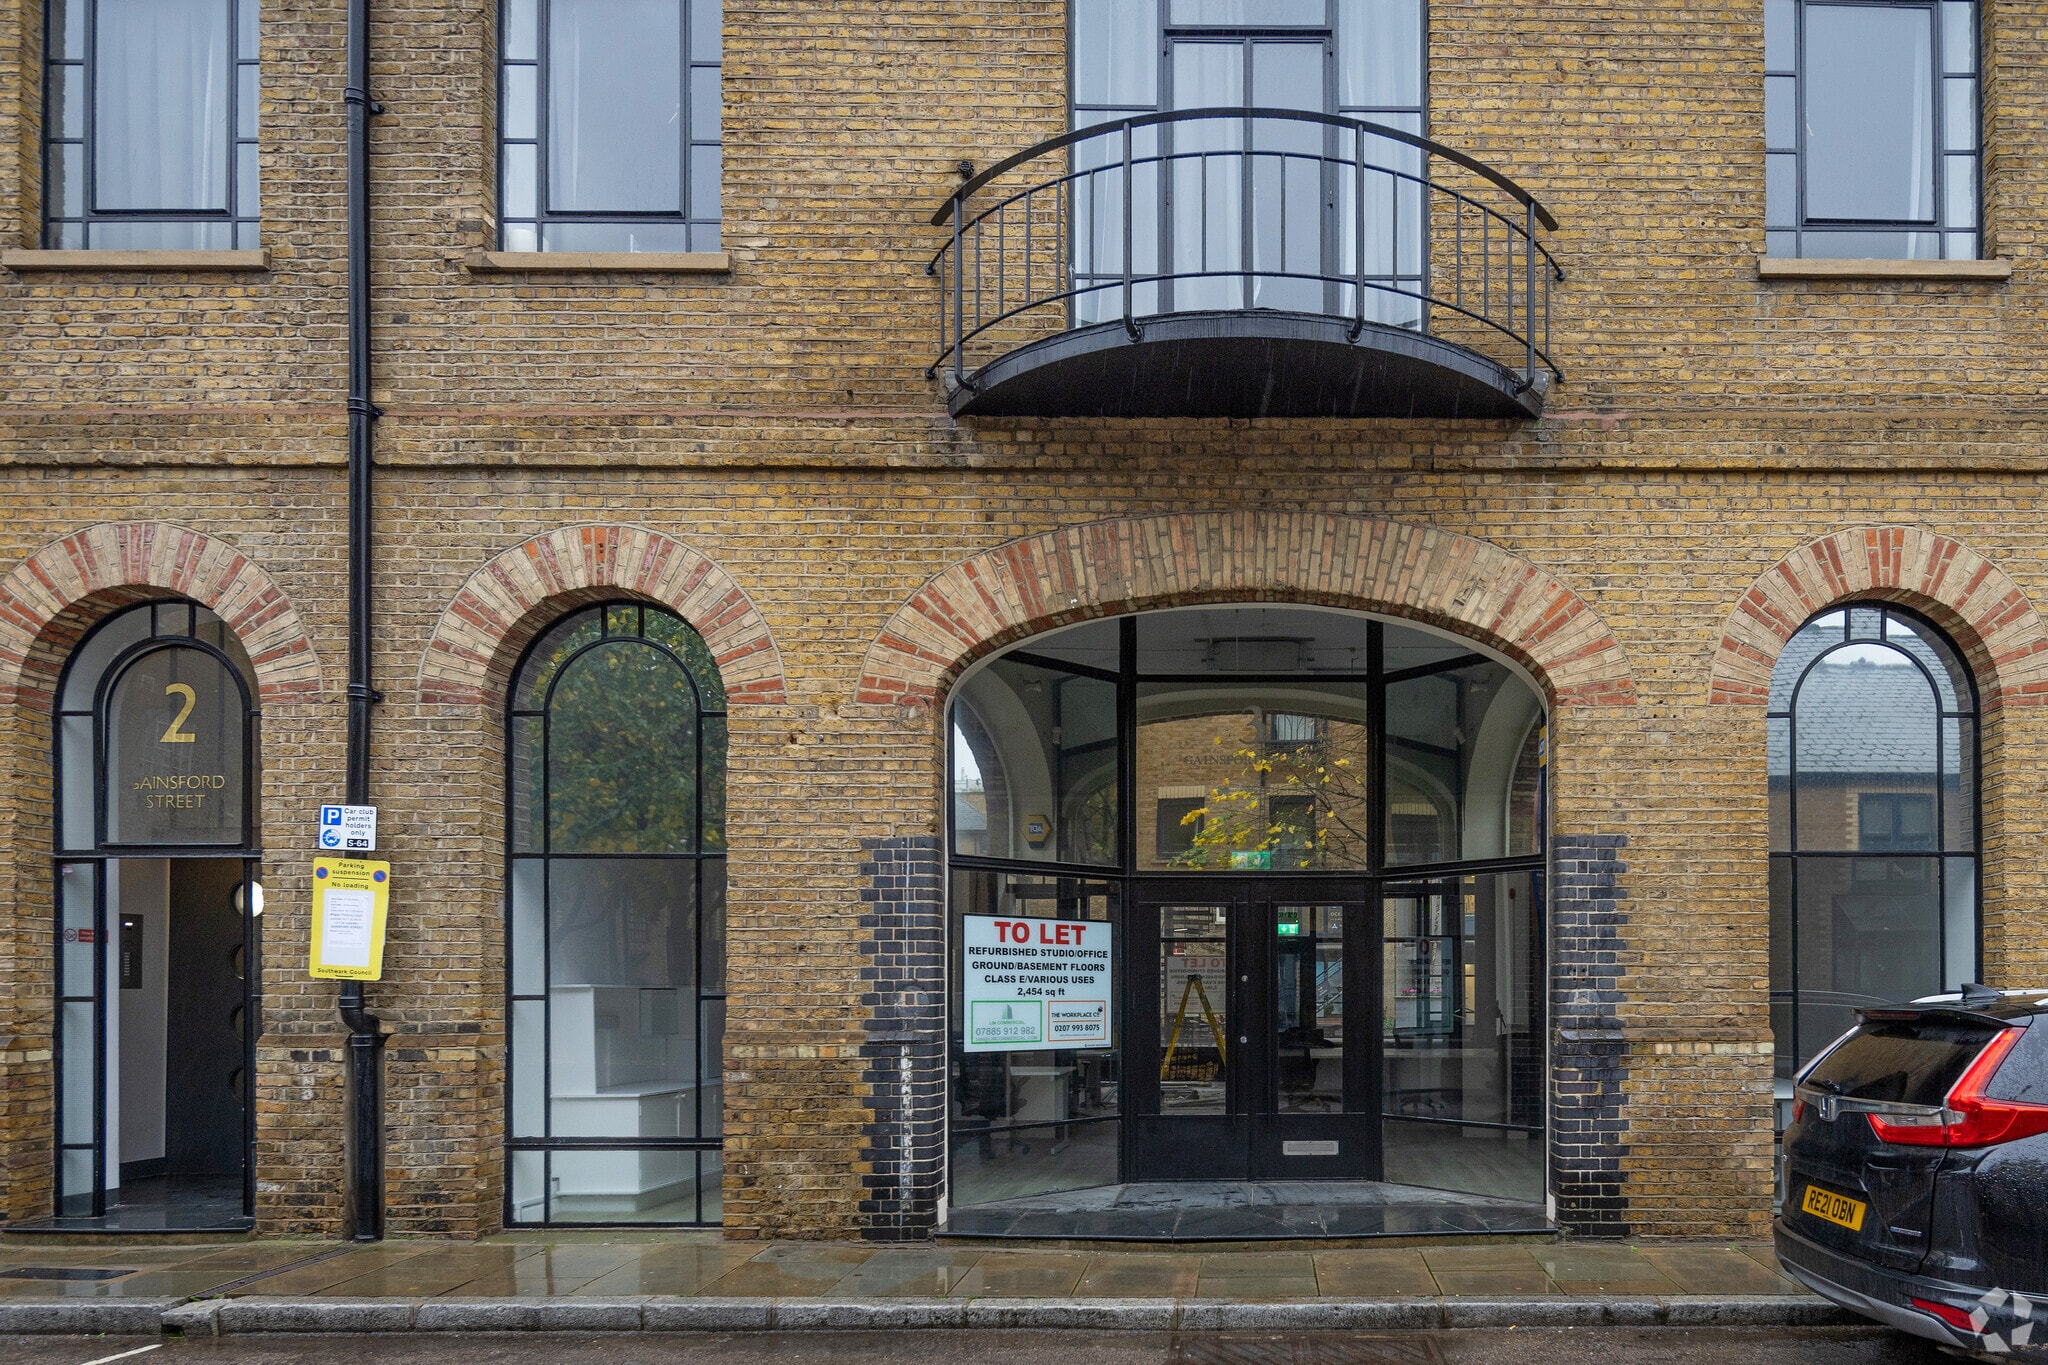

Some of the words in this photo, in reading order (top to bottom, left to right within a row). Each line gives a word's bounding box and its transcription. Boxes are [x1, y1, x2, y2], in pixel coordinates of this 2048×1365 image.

[160, 683, 196, 742] 2
[1238, 705, 1266, 744] 3
[146, 794, 206, 809] STREET
[327, 809, 340, 824] P
[338, 862, 365, 870] Parking
[994, 921, 1030, 944] TO
[1040, 924, 1087, 945] LET
[968, 947, 1038, 956] REFURBISHED
[1040, 949, 1108, 959] STUDIO/OFFICE
[972, 961, 1067, 971] GROUND/BASEMENT
[1070, 963, 1105, 972] FLOORS
[984, 975, 1016, 983] CLASS
[1019, 975, 1069, 984] E/VARIOUS
[1071, 976, 1095, 984] USES
[1017, 987, 1042, 997] 2,454
[1045, 989, 1056, 997] sq
[1058, 987, 1065, 996] ft
[976, 1027, 1001, 1036] 07885
[1003, 1027, 1018, 1035] 912
[1020, 1027, 1036, 1035] 982
[1807, 1190, 1833, 1215] RE21
[1832, 1198, 1856, 1223] OBN
